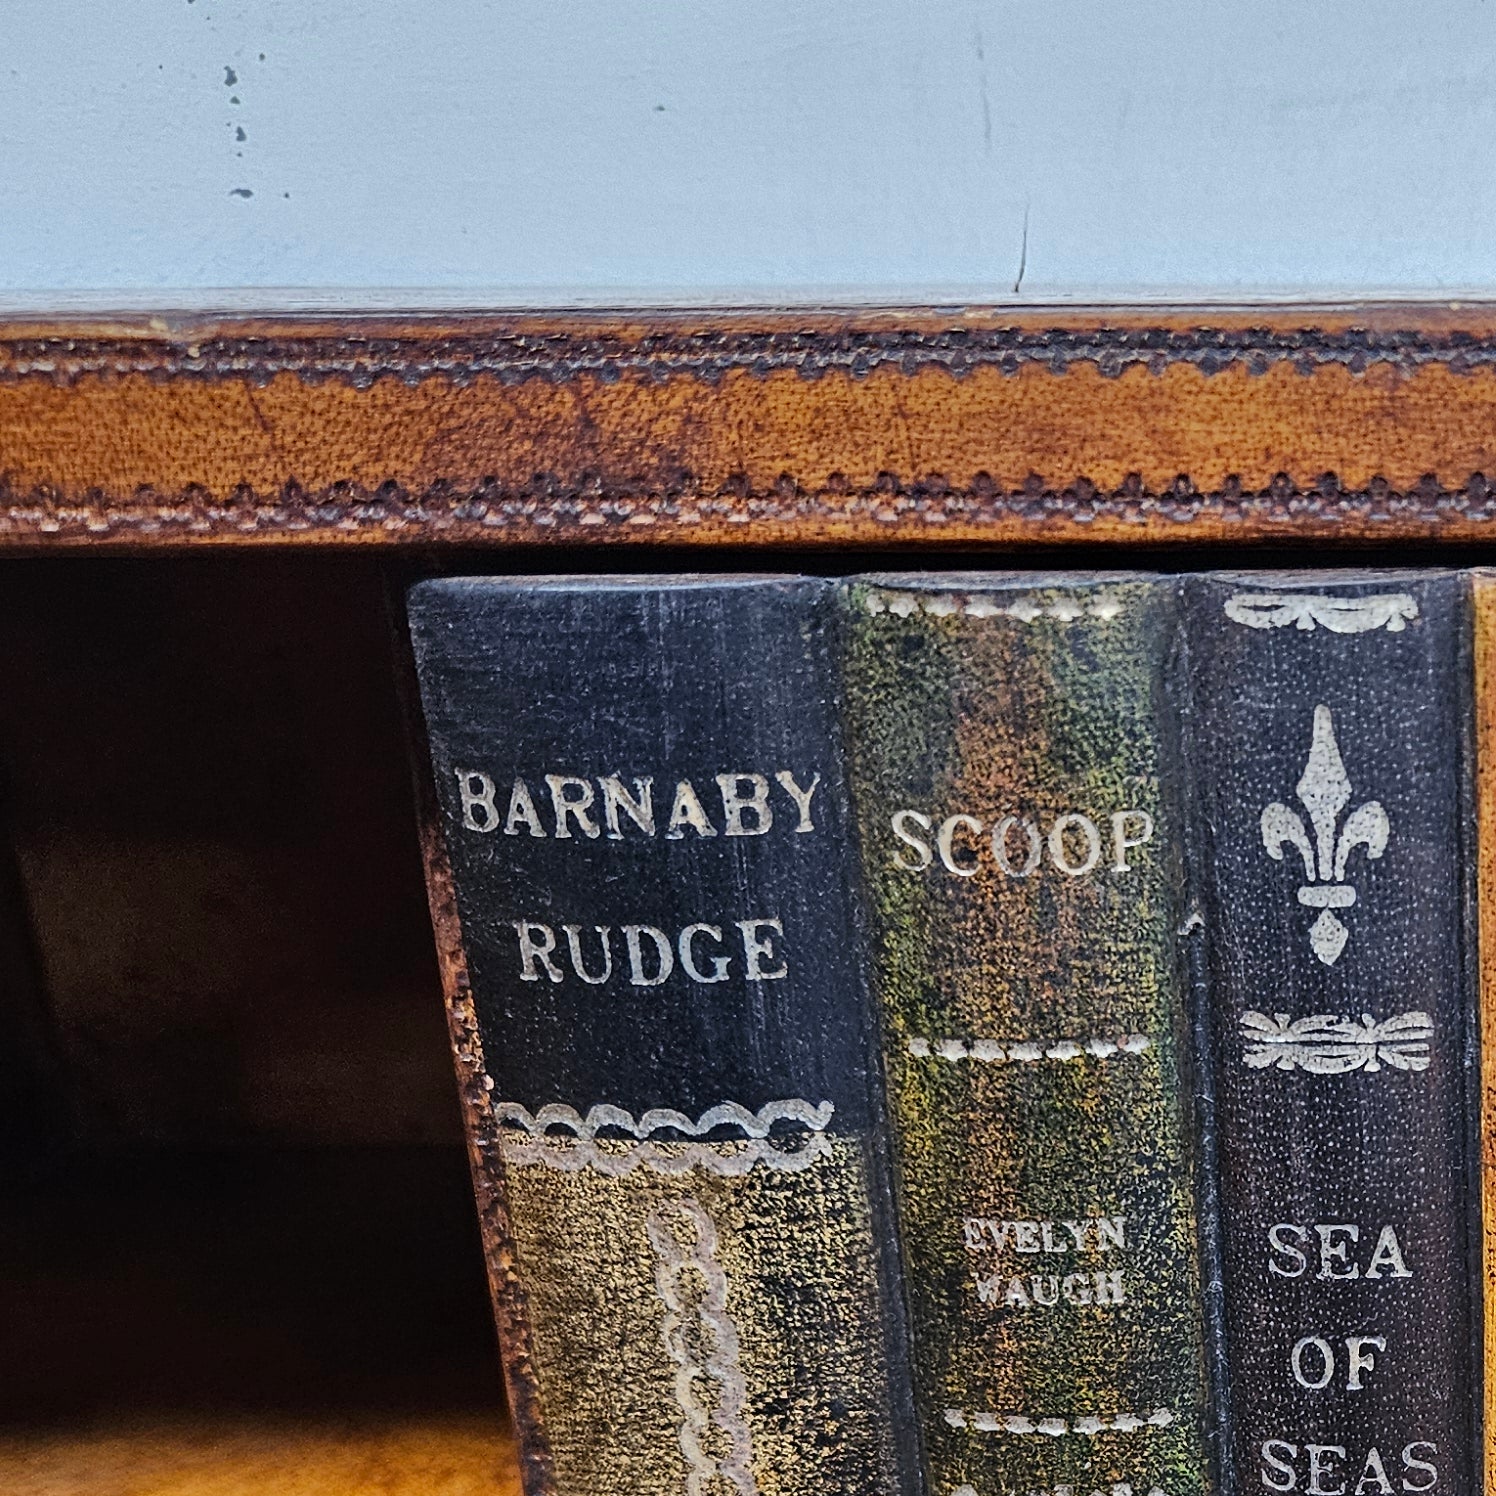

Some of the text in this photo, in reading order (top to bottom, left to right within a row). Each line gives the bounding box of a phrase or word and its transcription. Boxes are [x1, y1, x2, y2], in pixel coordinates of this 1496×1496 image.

[455, 767, 822, 840] BARNABY
[891, 809, 1155, 877] SCOOP
[516, 918, 789, 987] RUDGE
[963, 1216, 1127, 1254] EVELYN
[1268, 1223, 1413, 1280] SEA
[969, 1269, 1127, 1306] WAUGH
[1291, 1335, 1387, 1391] OF
[1260, 1439, 1438, 1496] SEAS
